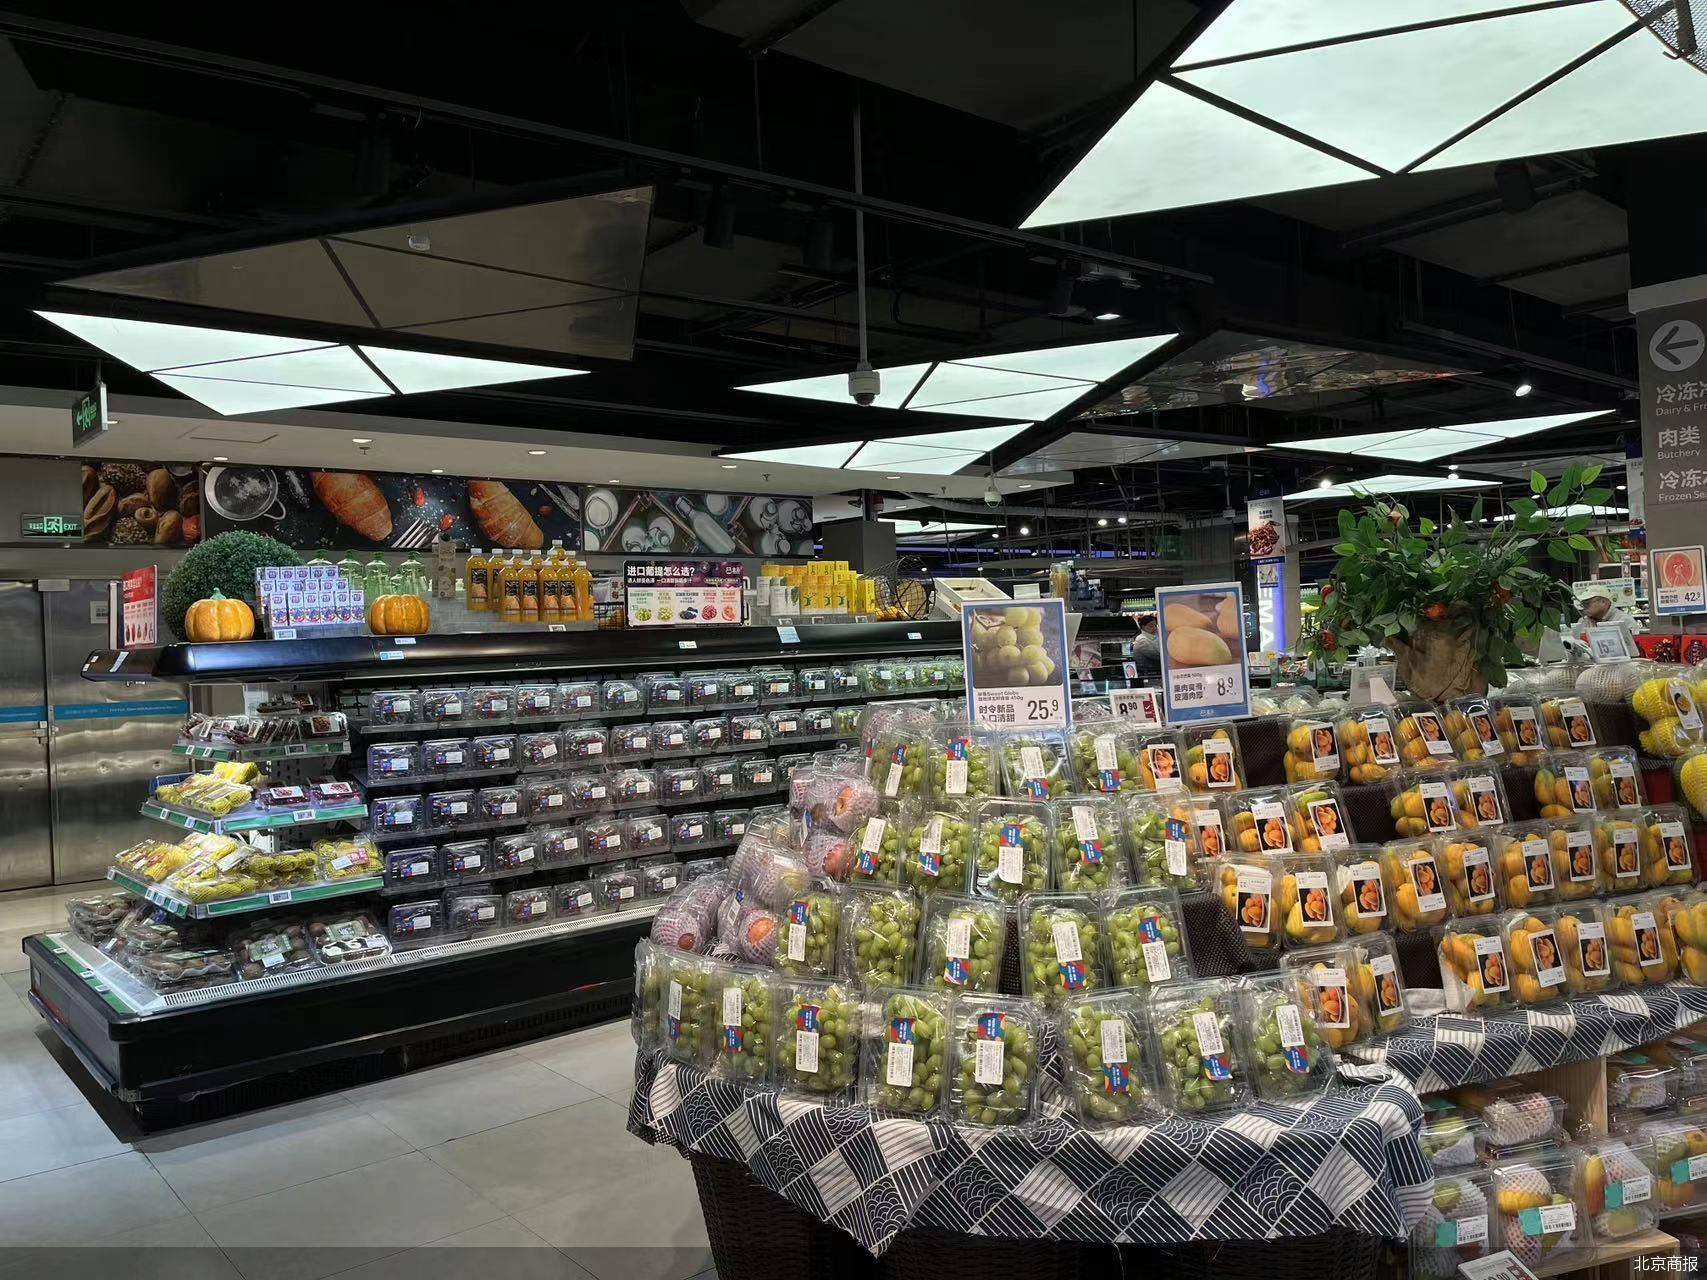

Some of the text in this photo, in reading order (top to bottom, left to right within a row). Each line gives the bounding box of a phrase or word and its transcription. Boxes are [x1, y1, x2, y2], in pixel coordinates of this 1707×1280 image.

[1656, 405, 1681, 416] Dairy
[1684, 403, 1691, 412] &
[1659, 426, 1700, 448] 肉类
[1658, 449, 1700, 460] Butchery
[1659, 492, 1691, 502] Frozen
[1217, 677, 1234, 696] 8.9
[979, 704, 1015, 714] 时令新品
[1027, 699, 1059, 720] 25.9
